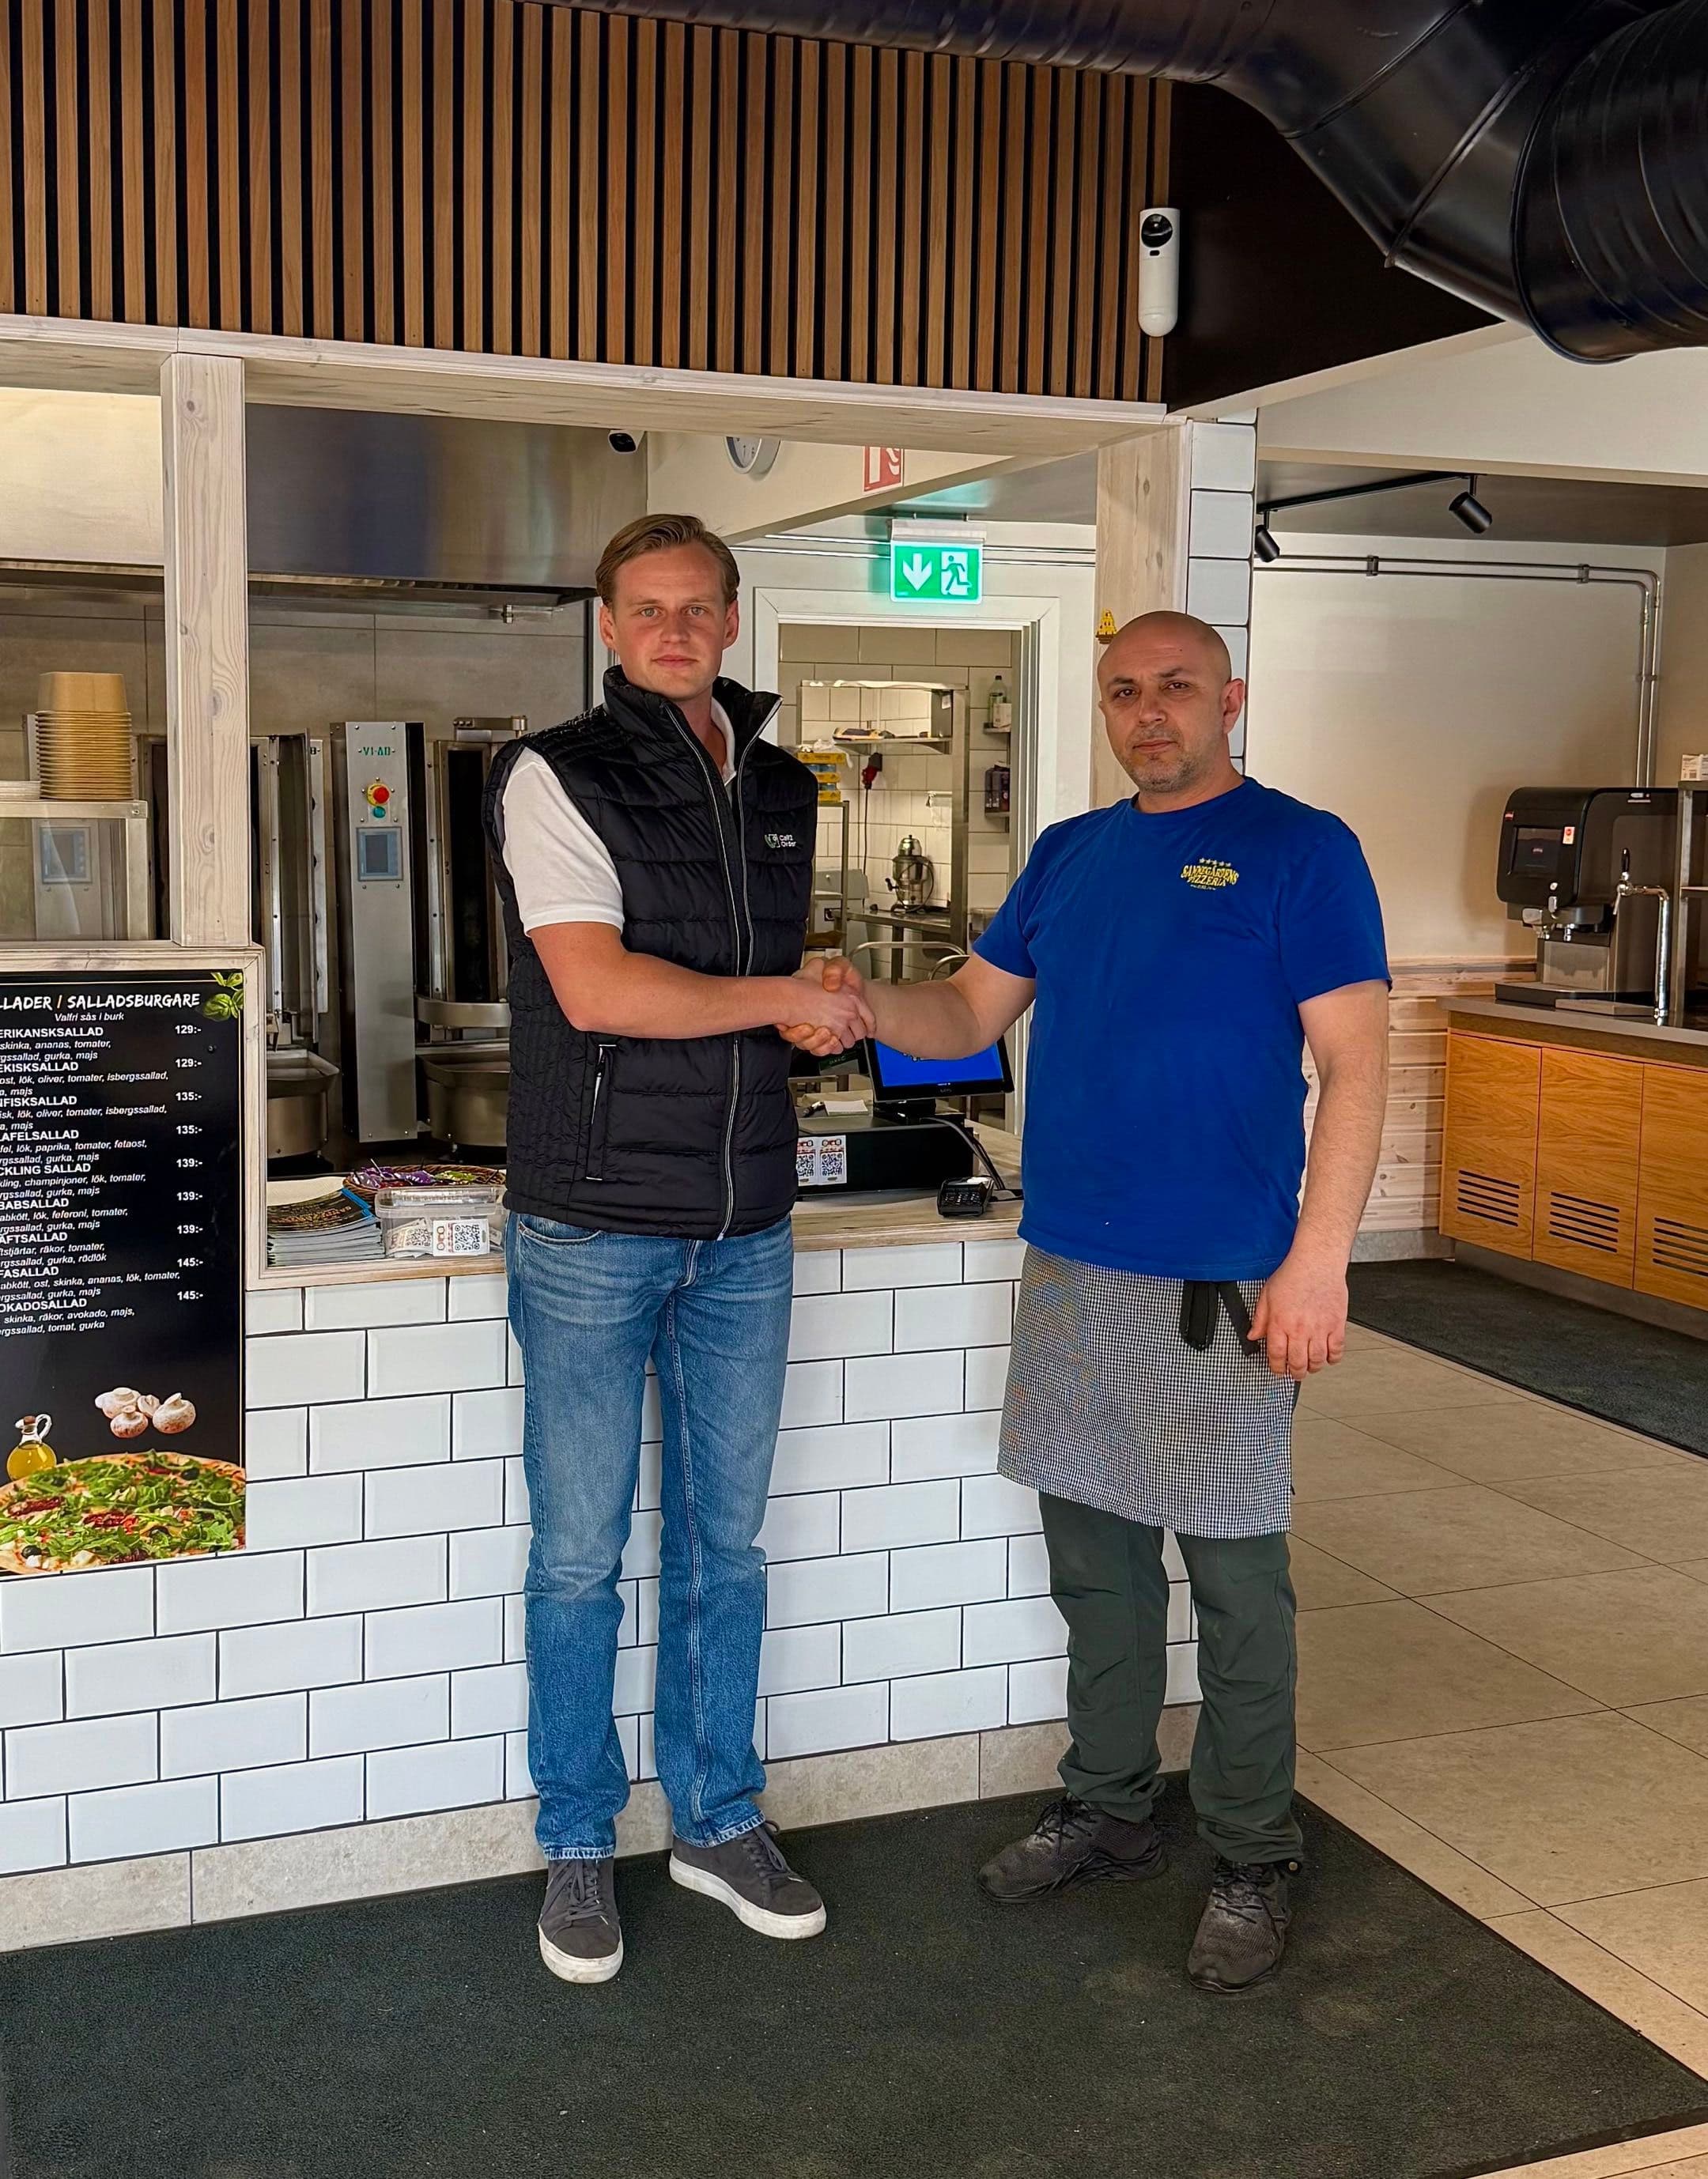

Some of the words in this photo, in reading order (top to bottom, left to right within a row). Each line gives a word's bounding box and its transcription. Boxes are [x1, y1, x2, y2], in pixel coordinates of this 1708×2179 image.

[1187, 874, 1226, 886] PIZZERIA
[0, 995, 53, 1011] LADER
[67, 993, 201, 1010] SALLADSBURGARE
[55, 1013, 78, 1022] Valfri
[80, 1013, 96, 1022] sås
[104, 1012, 124, 1021] burk
[175, 1025, 202, 1034] 129:-
[0, 1052, 41, 1063] gssallad,
[44, 1051, 73, 1062] gurka,
[76, 1050, 98, 1061] majs
[175, 1059, 202, 1068] 129:-
[10, 1086, 33, 1097] majs
[176, 1092, 202, 1101] 135:-
[11, 1121, 33, 1131] majs
[176, 1125, 202, 1135] 135:-
[46, 1154, 74, 1164] gurka,
[77, 1152, 100, 1162] majs
[43, 1163, 91, 1173] SALLAD
[176, 1158, 203, 1168] 139:-
[46, 1188, 75, 1198] gurka,
[77, 1186, 100, 1196] majs
[176, 1191, 203, 1201] 139:-
[47, 1222, 75, 1233] gurka,
[77, 1220, 100, 1230] majs
[176, 1225, 203, 1234] 139:-
[47, 1256, 76, 1266] gurka,
[177, 1258, 203, 1267] 145:-
[0, 1290, 45, 1302] rgssallad,
[47, 1290, 76, 1300] gurka,
[78, 1287, 101, 1297] majs
[177, 1291, 203, 1301] 145:-
[111, 1307, 135, 1317] majs,
[0, 1324, 46, 1337] rgssallad,
[78, 1320, 105, 1331] gurka
